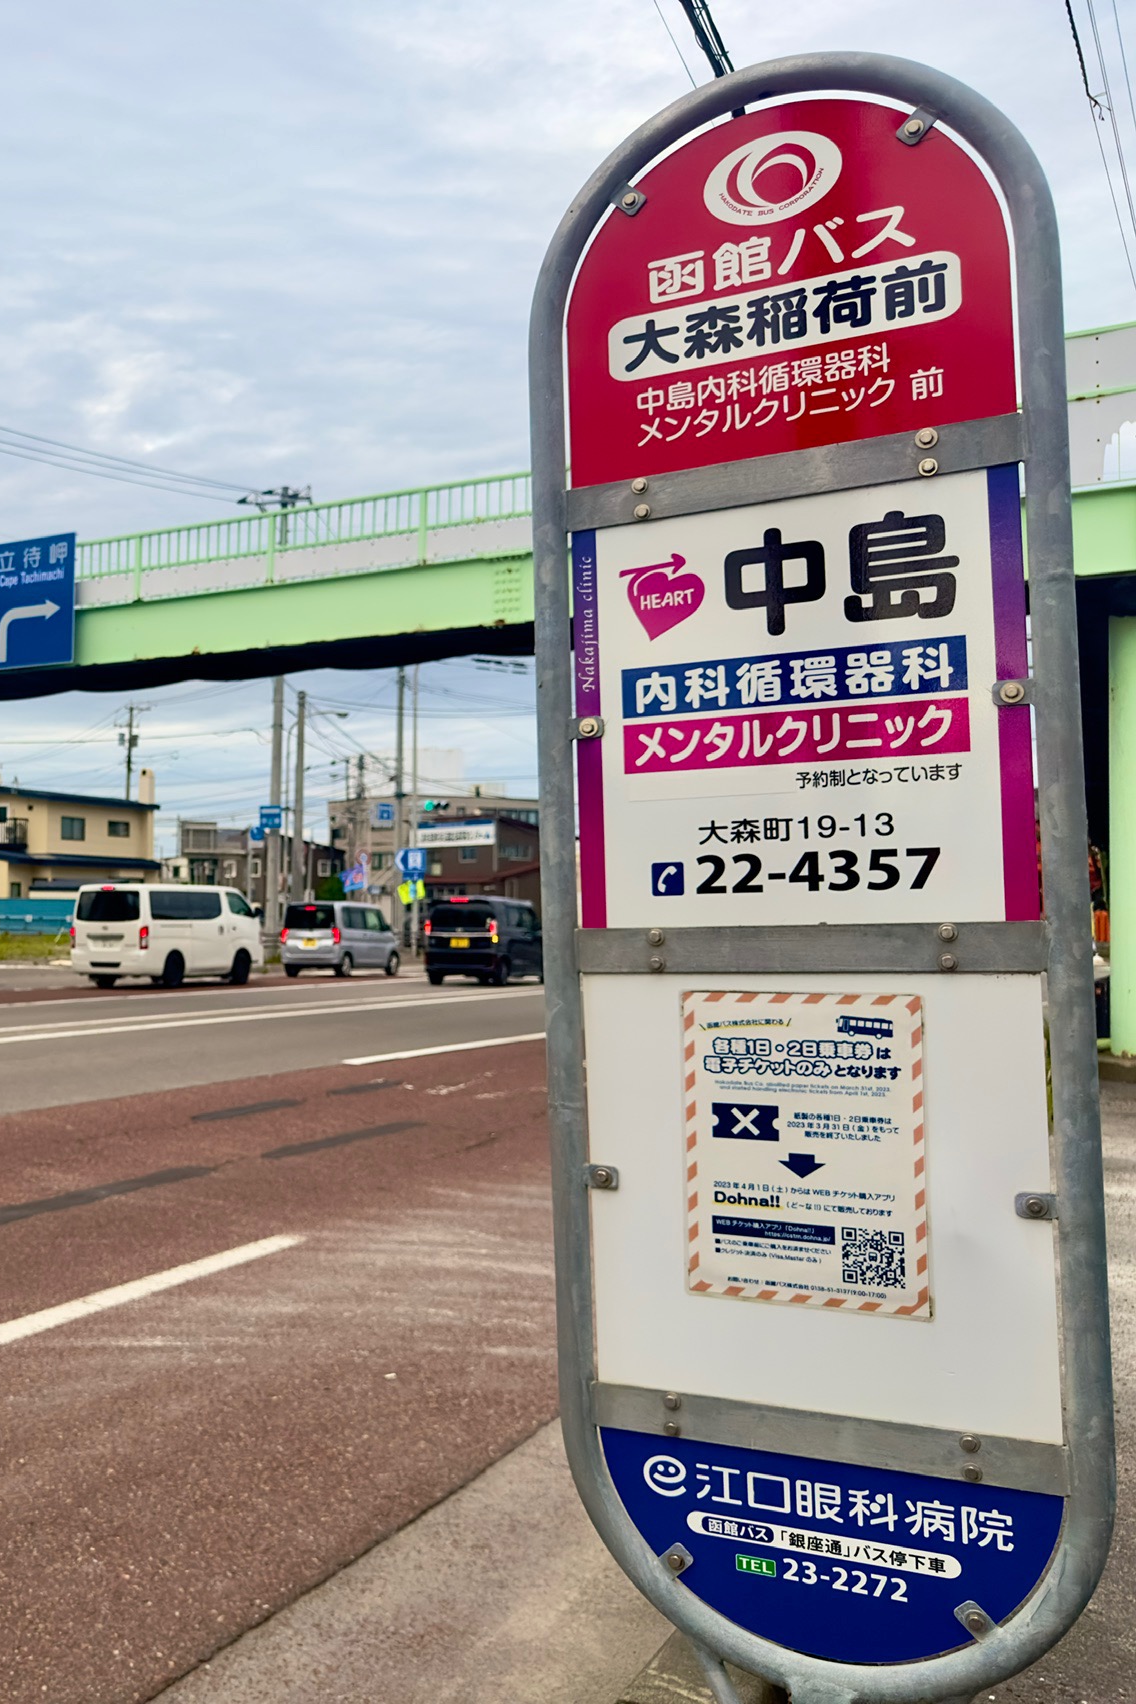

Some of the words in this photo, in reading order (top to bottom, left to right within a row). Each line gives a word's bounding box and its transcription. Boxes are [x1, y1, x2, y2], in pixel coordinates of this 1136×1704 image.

[719, 192, 753, 216] HAKODATE
[758, 208, 774, 216] BUS
[778, 168, 824, 210] CORPORATION
[648, 206, 916, 303] 函館バス
[624, 260, 948, 372] 大森稲荷前
[637, 342, 890, 416] 中島内科循環器科
[638, 378, 895, 447] メンタルクリニック
[910, 368, 944, 400] 前
[0, 575, 18, 588] Cape
[20, 568, 64, 585] Tachimachi
[577, 556, 593, 602] clinic
[640, 588, 695, 611] HEART
[724, 510, 960, 636] 中島
[578, 609, 598, 692] Nakajima
[635, 643, 954, 714] 内科循環器科
[634, 704, 954, 766] メンタルクリニック
[796, 763, 962, 790] 予約制となっています
[698, 813, 894, 844] 大森町19-13
[696, 846, 941, 894] 22-4357
[714, 1190, 780, 1208] Dohna!!
[696, 1463, 1014, 1552] 江口眼科病院
[708, 1519, 769, 1542] 函館バス
[780, 1530, 946, 1574] 「銀座通」バス停下車
[738, 1557, 772, 1575] TEL
[782, 1558, 908, 1602] 23-2272
